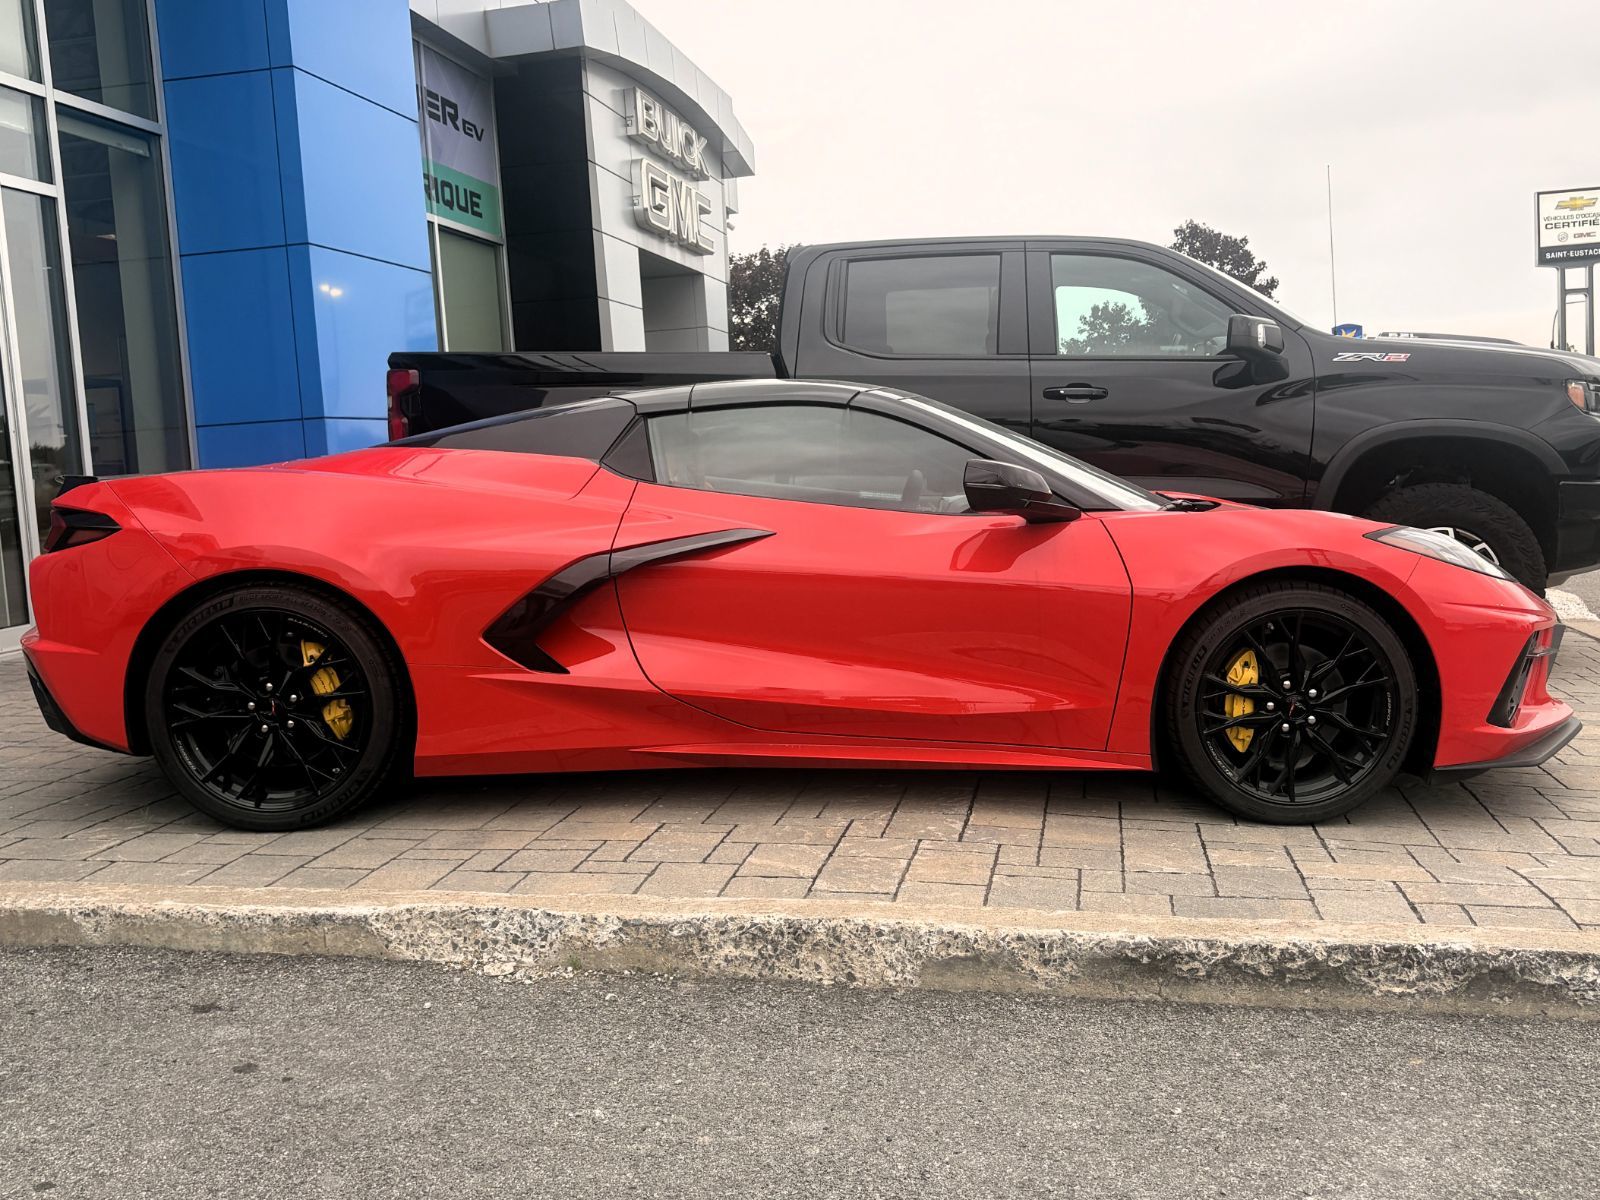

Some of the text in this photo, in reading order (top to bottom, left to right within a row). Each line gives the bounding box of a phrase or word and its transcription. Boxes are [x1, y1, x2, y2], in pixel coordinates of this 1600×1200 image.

[416, 84, 484, 142] ER EV
[632, 86, 711, 178] BUICK
[639, 158, 715, 253] GMC
[1332, 352, 1412, 362] ZR2
